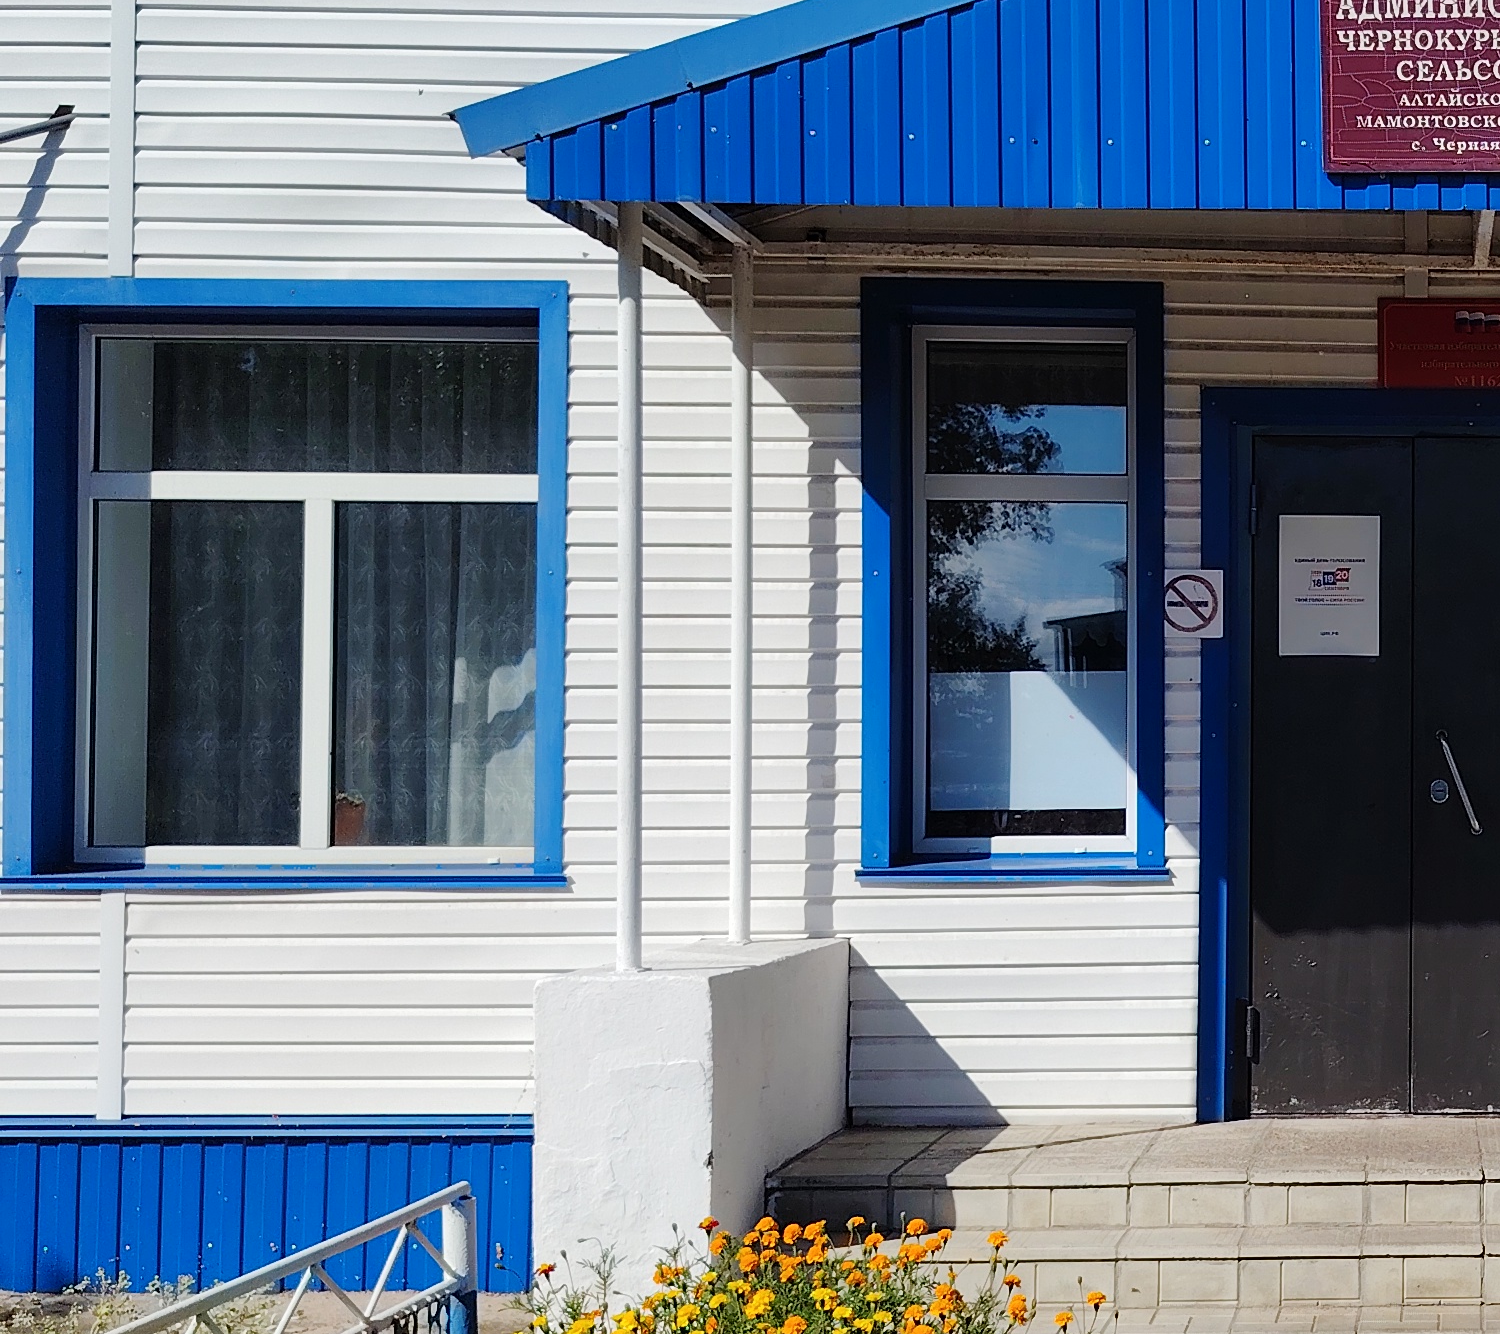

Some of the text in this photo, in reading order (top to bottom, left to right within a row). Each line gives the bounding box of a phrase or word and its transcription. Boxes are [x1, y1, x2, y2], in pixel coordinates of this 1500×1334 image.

[1411, 140, 1426, 151] с.
[1432, 137, 1500, 155] Черная
[1389, 341, 1446, 352] Участковая
[1420, 358, 1500, 371] избирательного
[1312, 570, 1348, 587] 18 19 20
